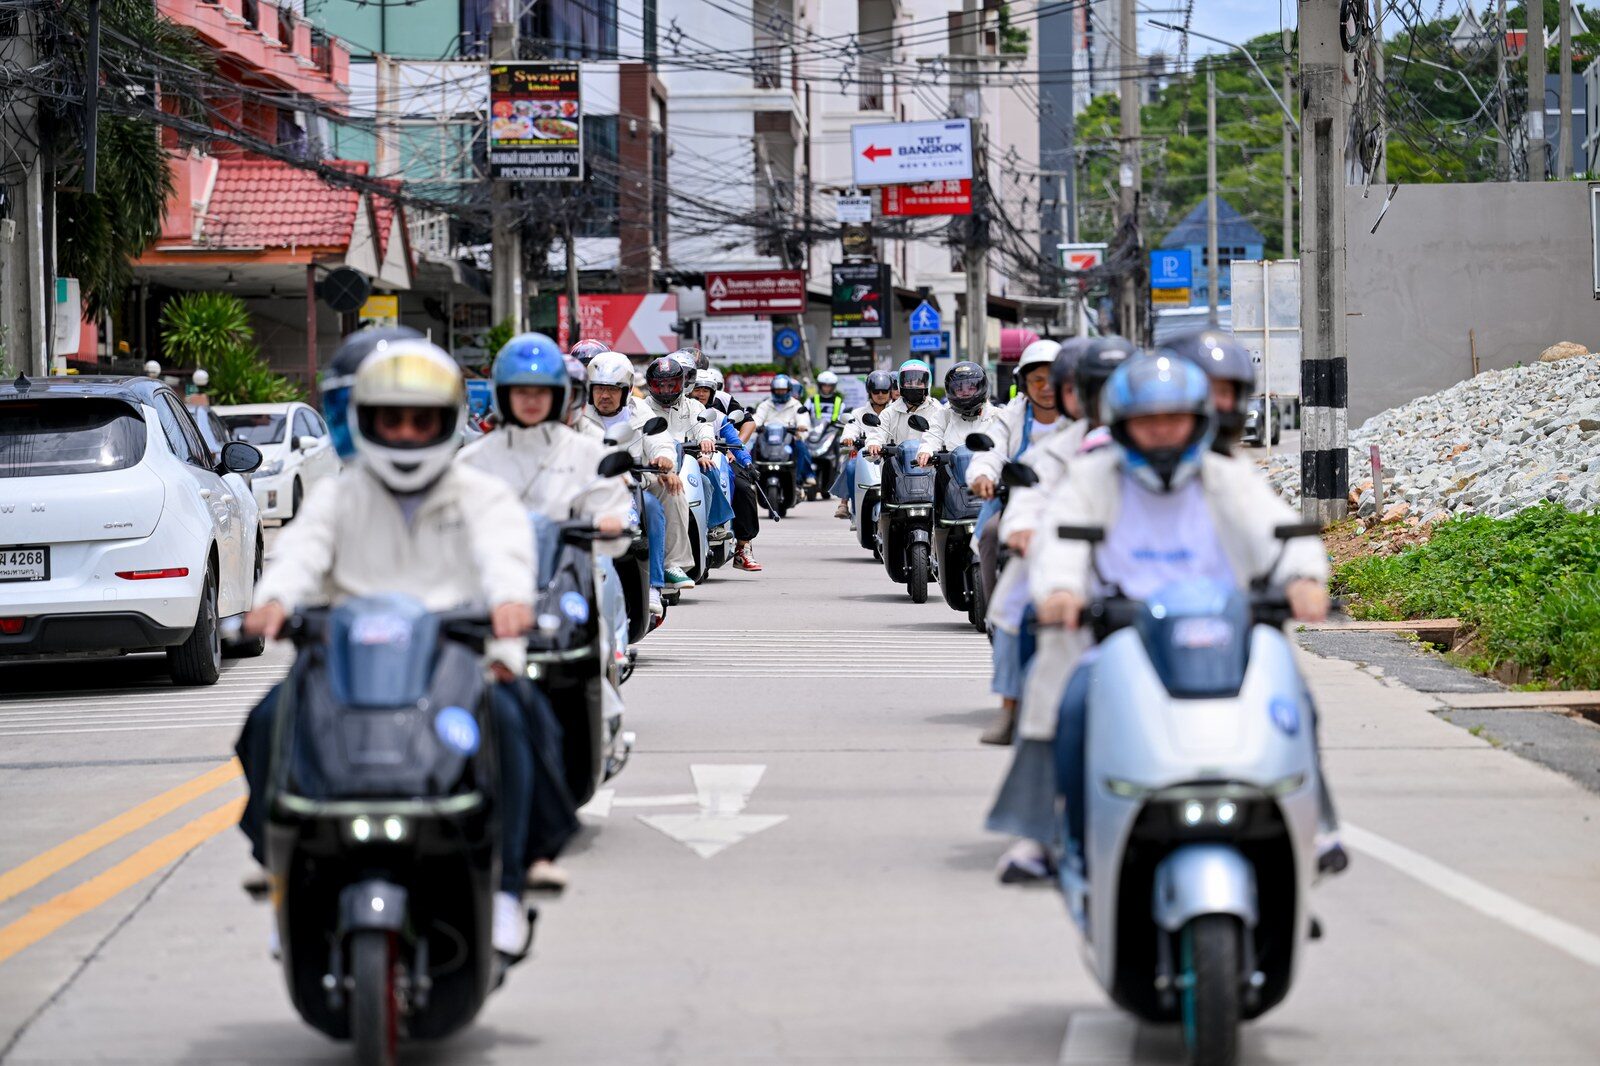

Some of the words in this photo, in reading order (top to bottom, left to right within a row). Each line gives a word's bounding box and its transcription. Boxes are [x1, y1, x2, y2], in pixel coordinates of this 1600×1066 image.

[513, 70, 577, 85] Swagat
[898, 143, 963, 156] BANGKOK
[9, 551, 43, 566] 4268
